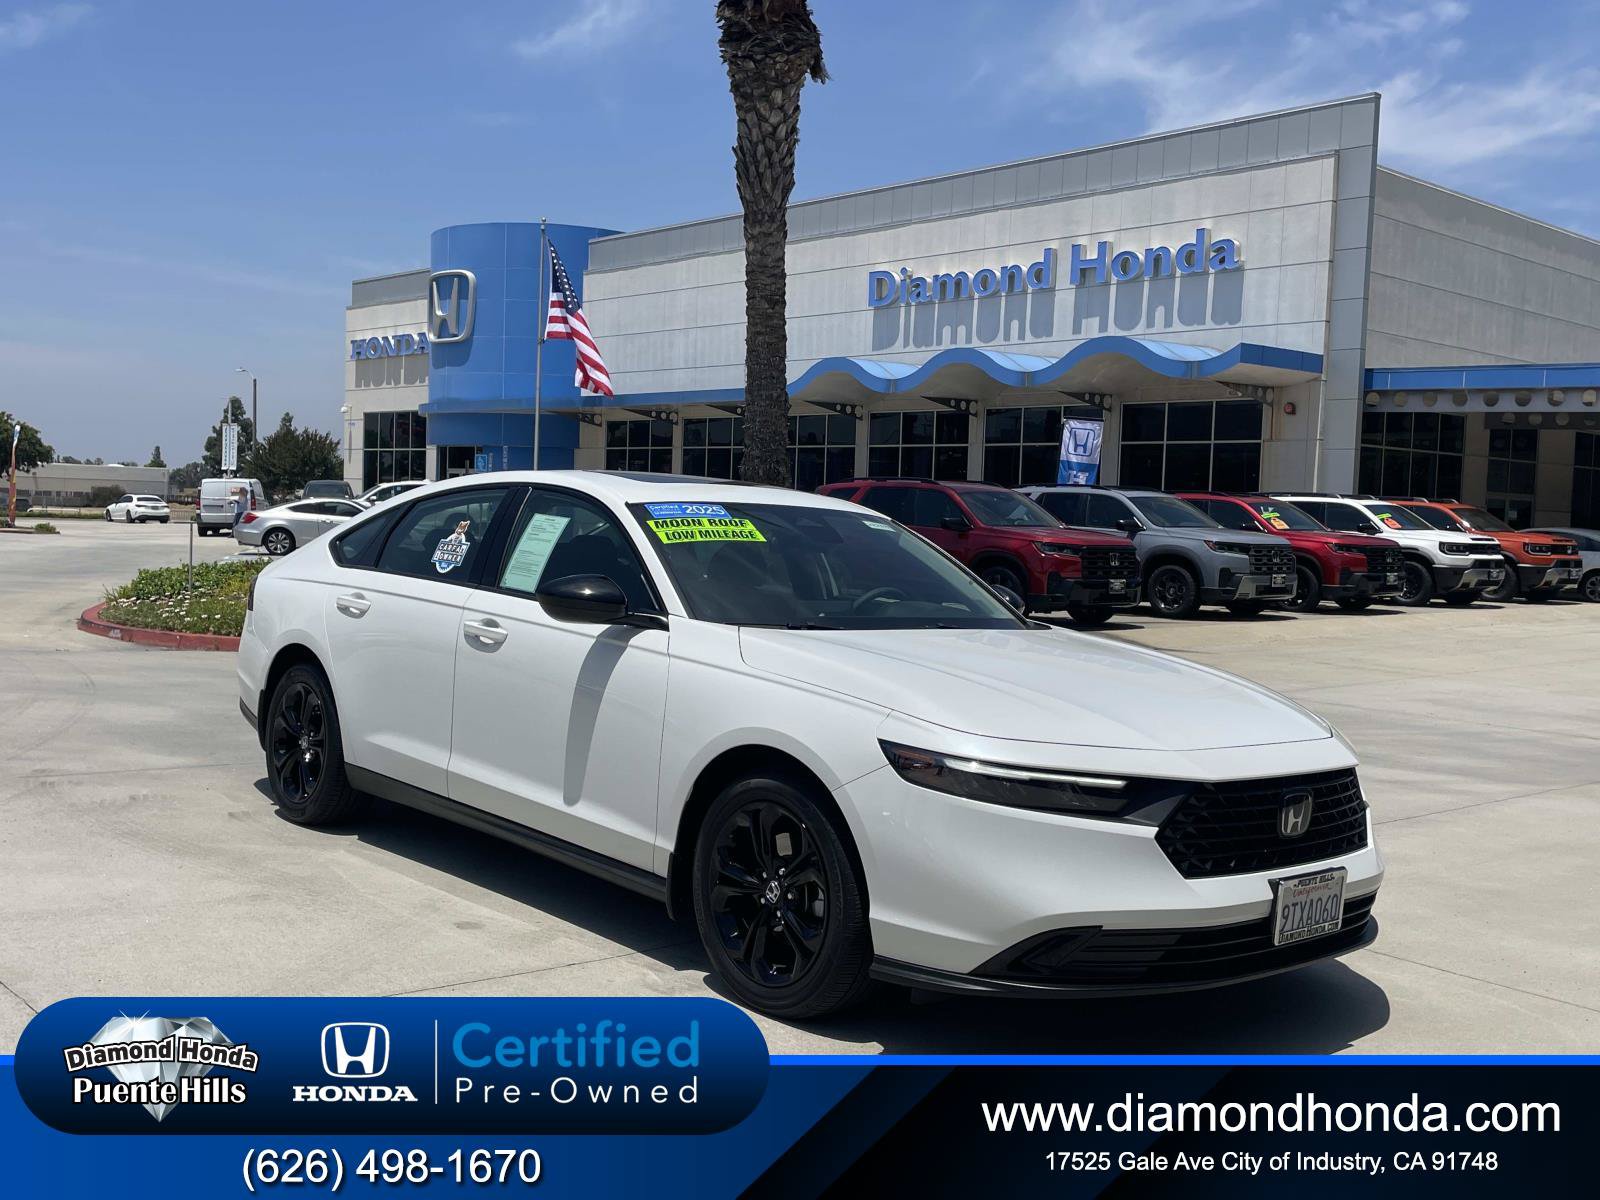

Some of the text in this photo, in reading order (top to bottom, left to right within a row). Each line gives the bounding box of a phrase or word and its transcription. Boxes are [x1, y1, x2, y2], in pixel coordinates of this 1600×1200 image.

[868, 227, 1241, 308] Diamond Honda
[350, 331, 431, 360] HONDA
[682, 505, 725, 516] 2025
[654, 518, 747, 529] MOON ROOF
[665, 530, 758, 541] LOW MILEAGE
[1280, 893, 1339, 932] 9TXA060
